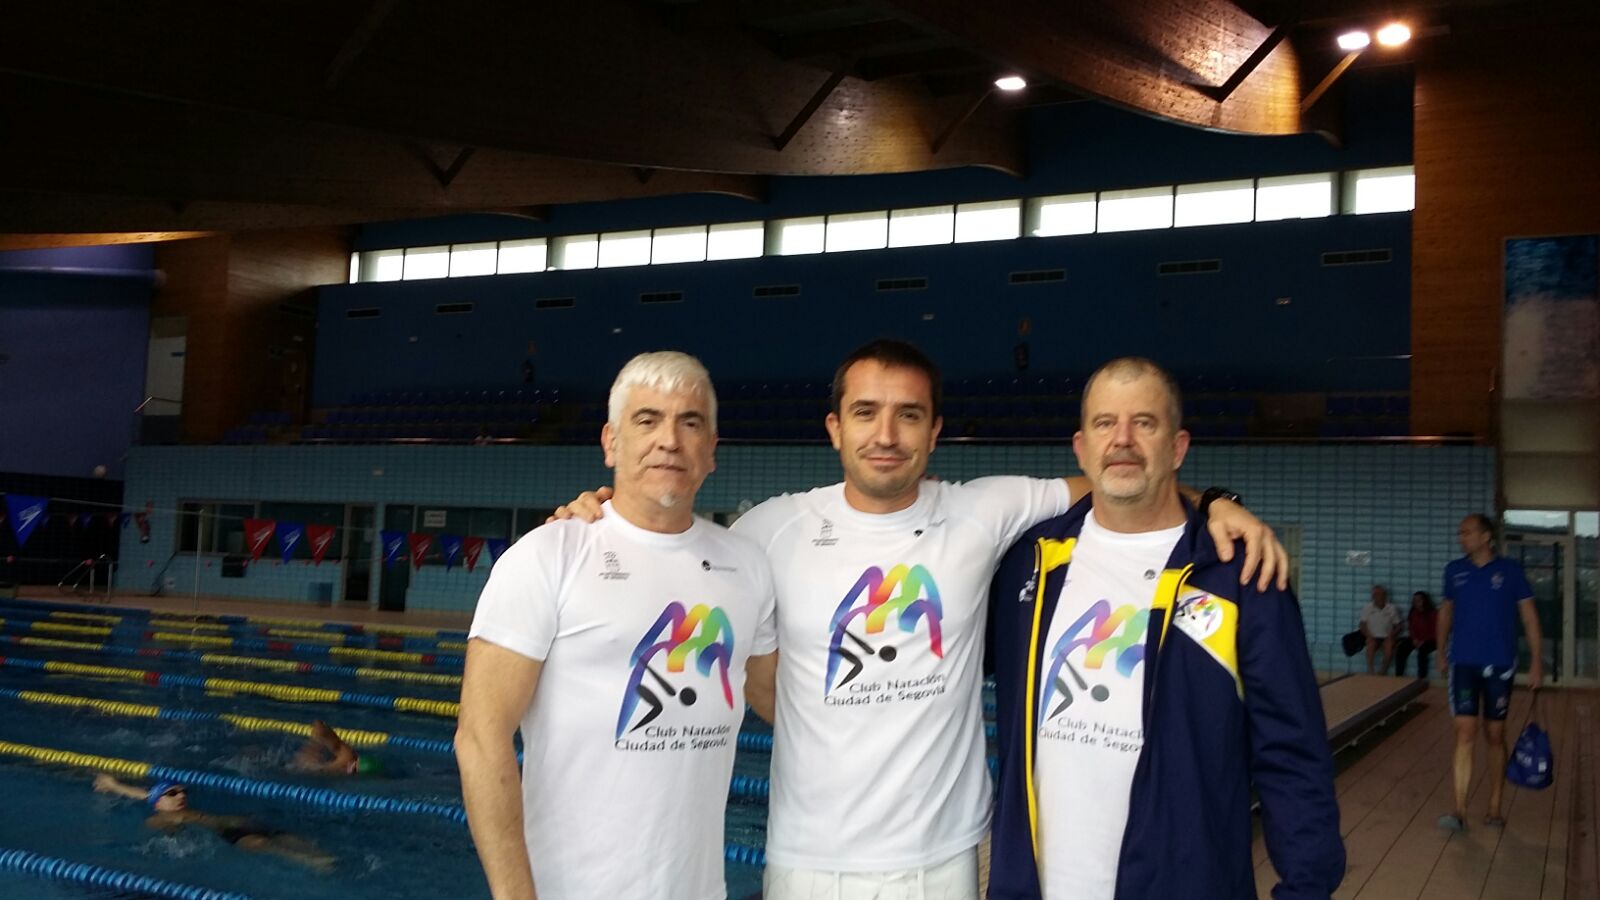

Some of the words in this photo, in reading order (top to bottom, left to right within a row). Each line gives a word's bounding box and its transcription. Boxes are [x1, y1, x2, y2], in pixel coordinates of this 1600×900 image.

[849, 682, 882, 694] Club
[824, 695, 870, 706] Ciudad
[876, 694, 892, 703] de
[644, 725, 678, 738] Club
[1058, 717, 1087, 730] Club
[1093, 722, 1141, 739] Nataci
[614, 739, 666, 752] Ciudad
[670, 739, 686, 751] de
[1039, 727, 1075, 742] Ciudad
[1080, 734, 1097, 744] de
[1103, 736, 1140, 752] Sego
